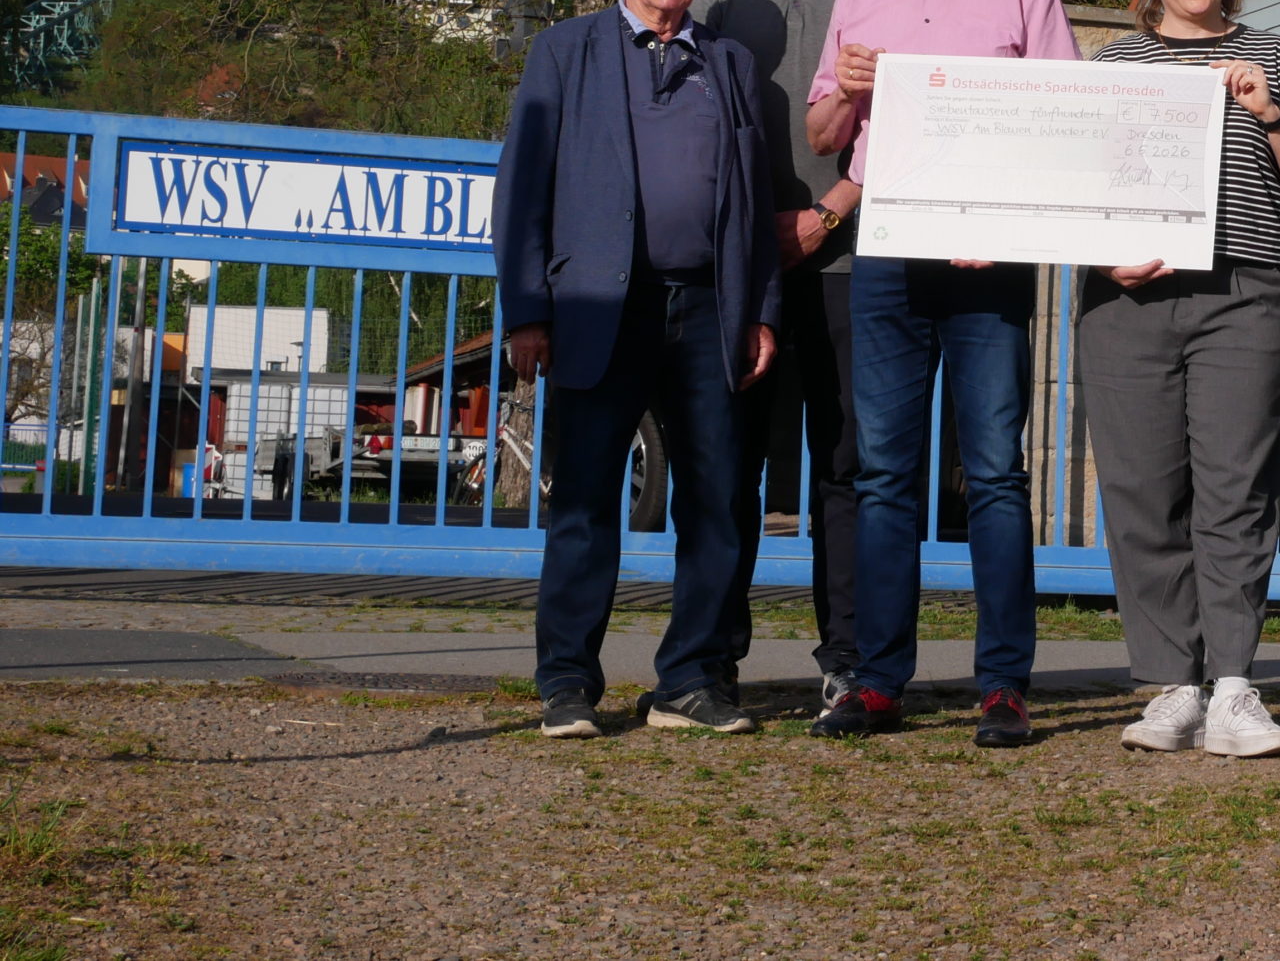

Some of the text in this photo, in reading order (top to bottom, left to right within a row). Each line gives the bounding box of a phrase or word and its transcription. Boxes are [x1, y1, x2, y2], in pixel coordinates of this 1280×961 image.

[952, 77, 1164, 97] Ostsächsische Sparkasse Dresden
[1127, 127, 1182, 141] Dresden
[149, 156, 270, 230] WSV
[421, 175, 492, 239] BL
